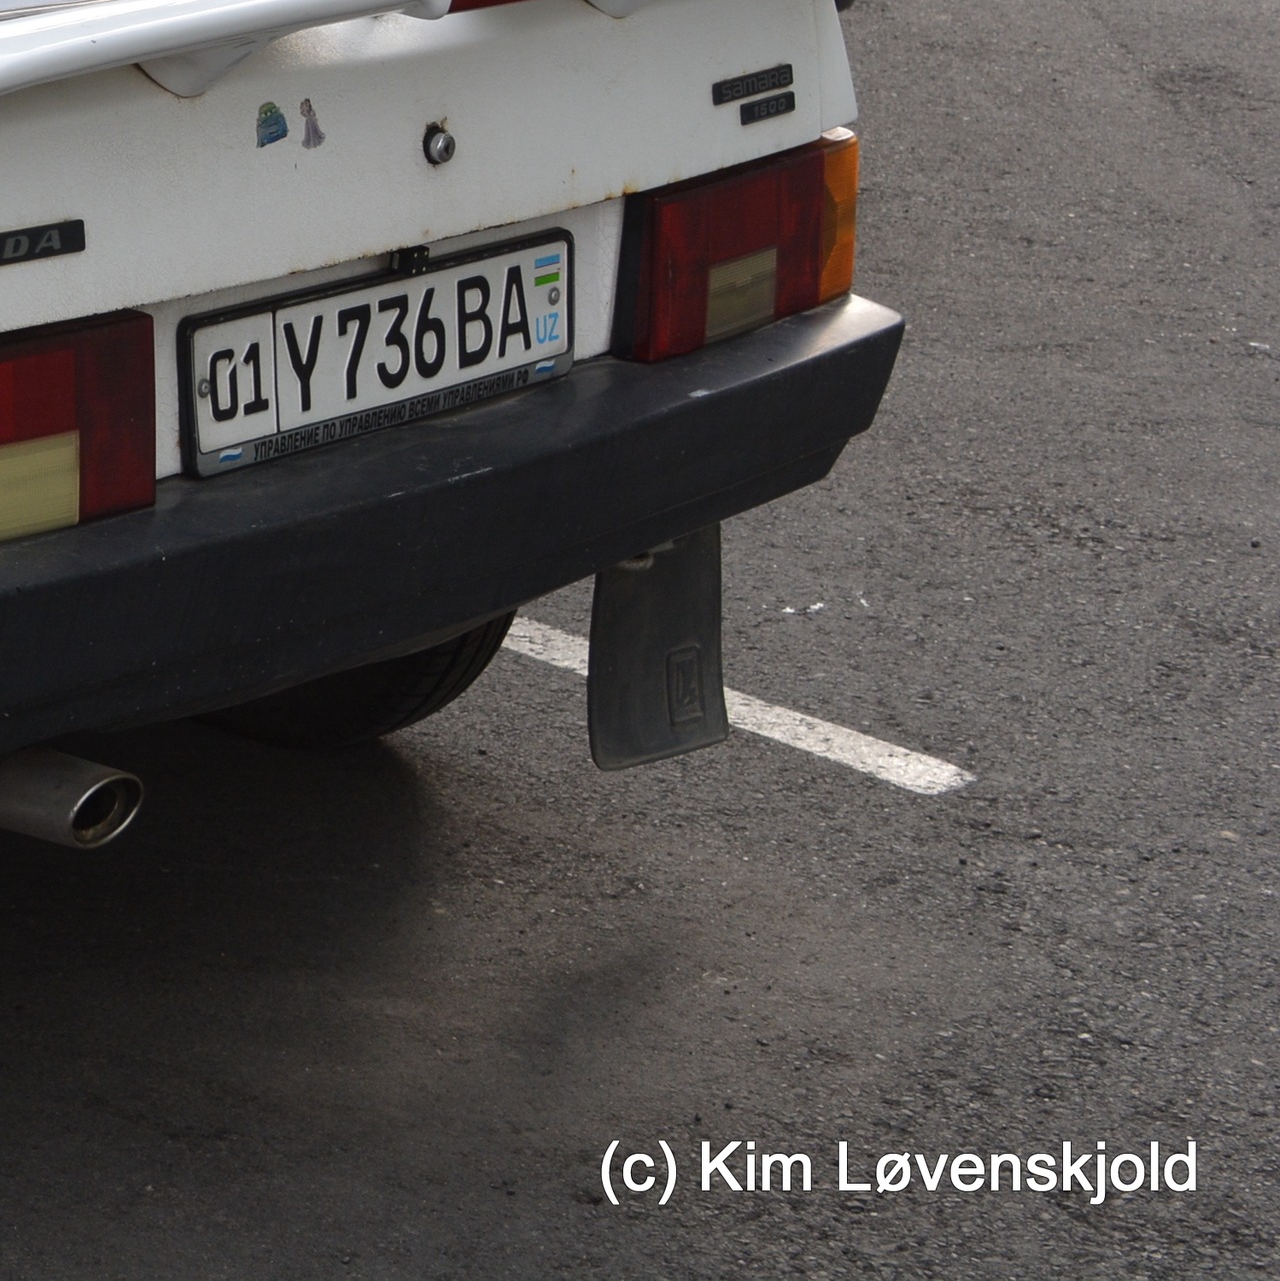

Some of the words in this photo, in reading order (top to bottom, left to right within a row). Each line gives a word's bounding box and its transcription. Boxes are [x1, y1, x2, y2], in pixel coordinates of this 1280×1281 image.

[754, 98, 786, 118] 1500
[536, 312, 560, 345] UZ
[209, 341, 269, 422] 01
[254, 426, 320, 461] УПРАВЛЕНИЕ
[322, 422, 336, 440] ПО
[339, 404, 407, 437] УПРАВЛЕНИЮ
[408, 393, 441, 418] ВСЕМИ
[441, 371, 515, 409] УПРАВЛЕНИЯМИ
[516, 369, 529, 386] РФ
